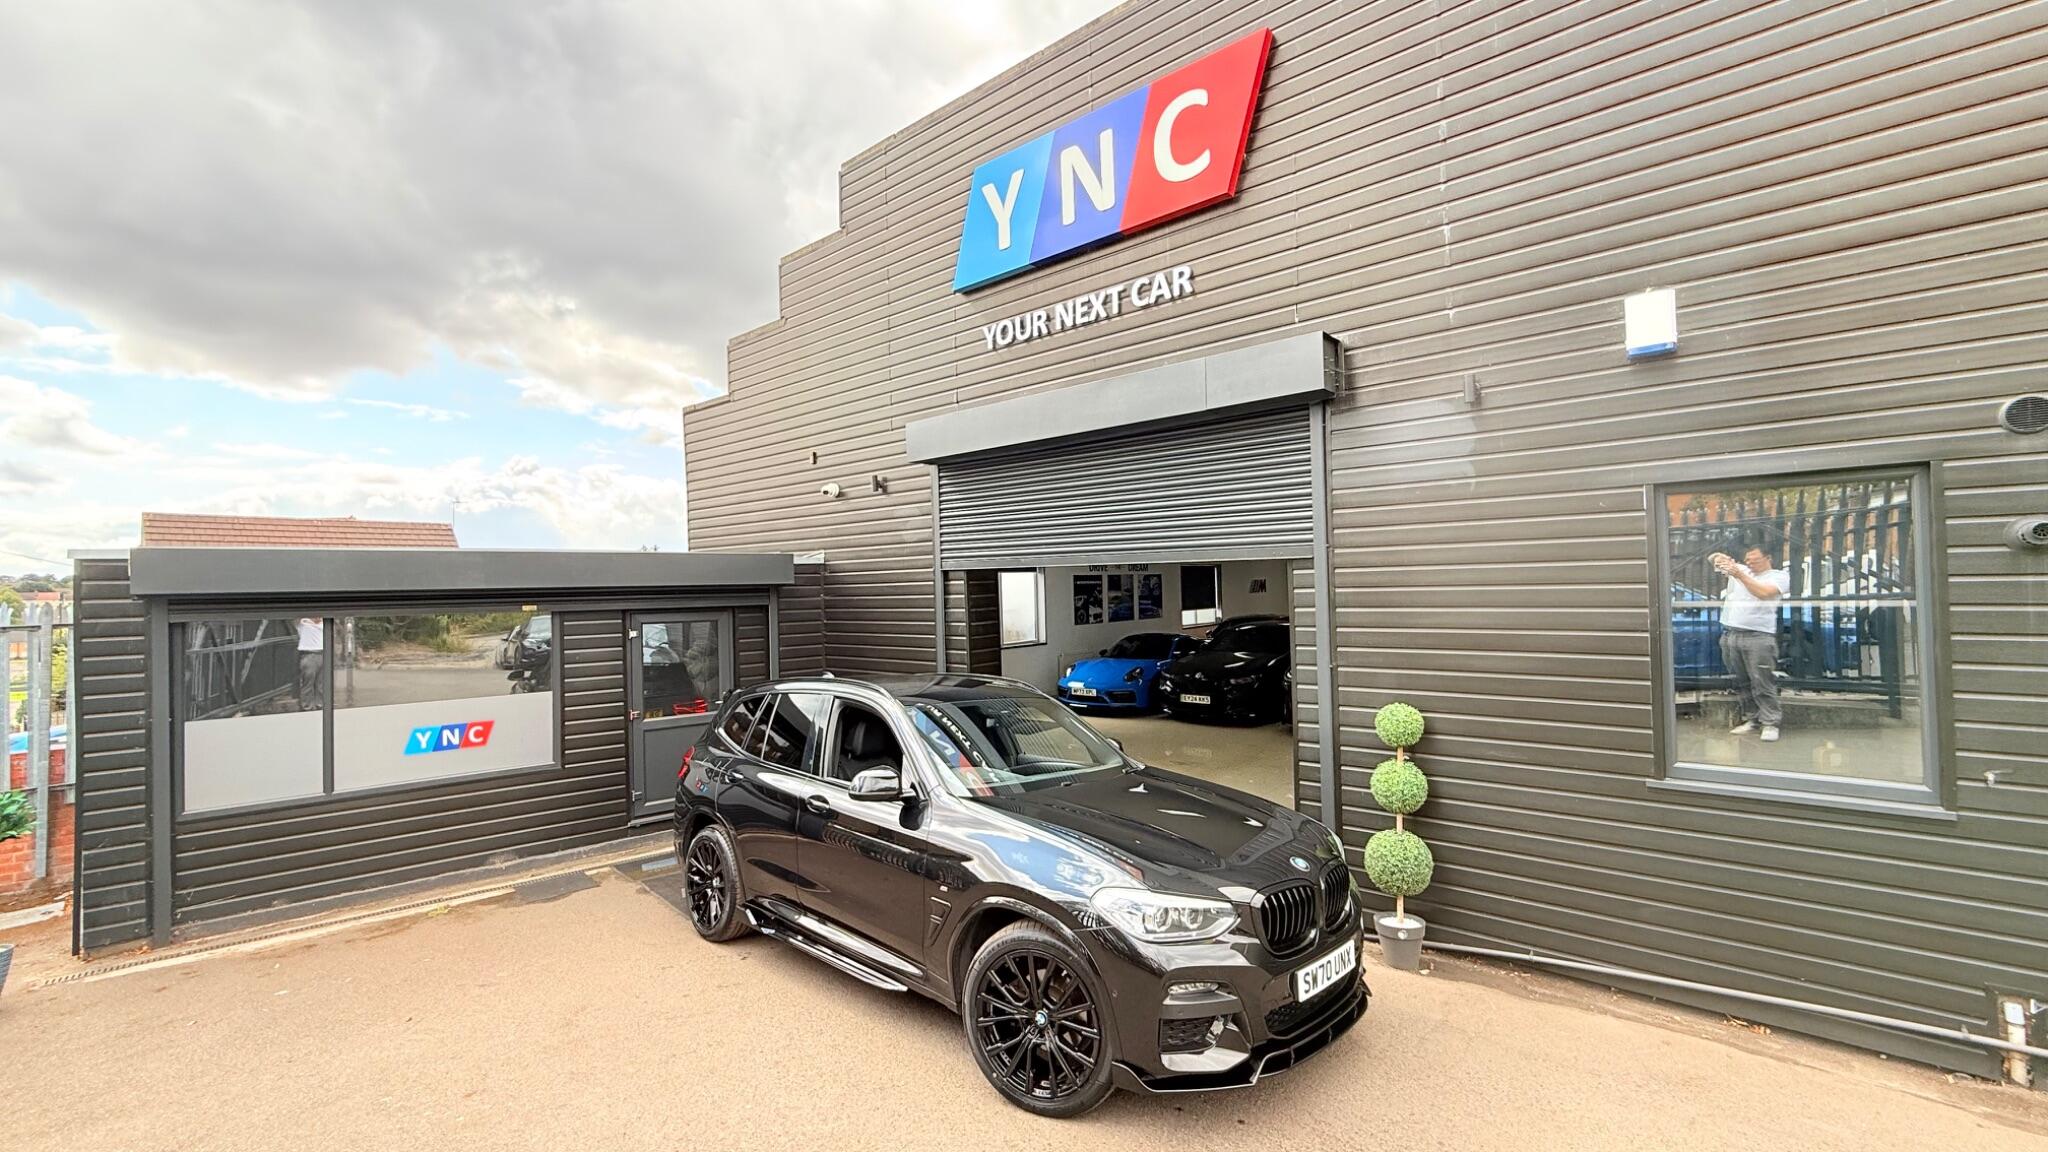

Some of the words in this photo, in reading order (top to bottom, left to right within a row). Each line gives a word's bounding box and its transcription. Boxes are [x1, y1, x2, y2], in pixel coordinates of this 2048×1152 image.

[981, 88, 1211, 251] YNC
[982, 310, 1048, 350] YOUR
[1054, 288, 1126, 329] NEXT
[1130, 265, 1195, 307] CAR
[415, 725, 484, 749] YNC
[1303, 959, 1333, 995] SW70
[1333, 945, 1352, 976] UNX
